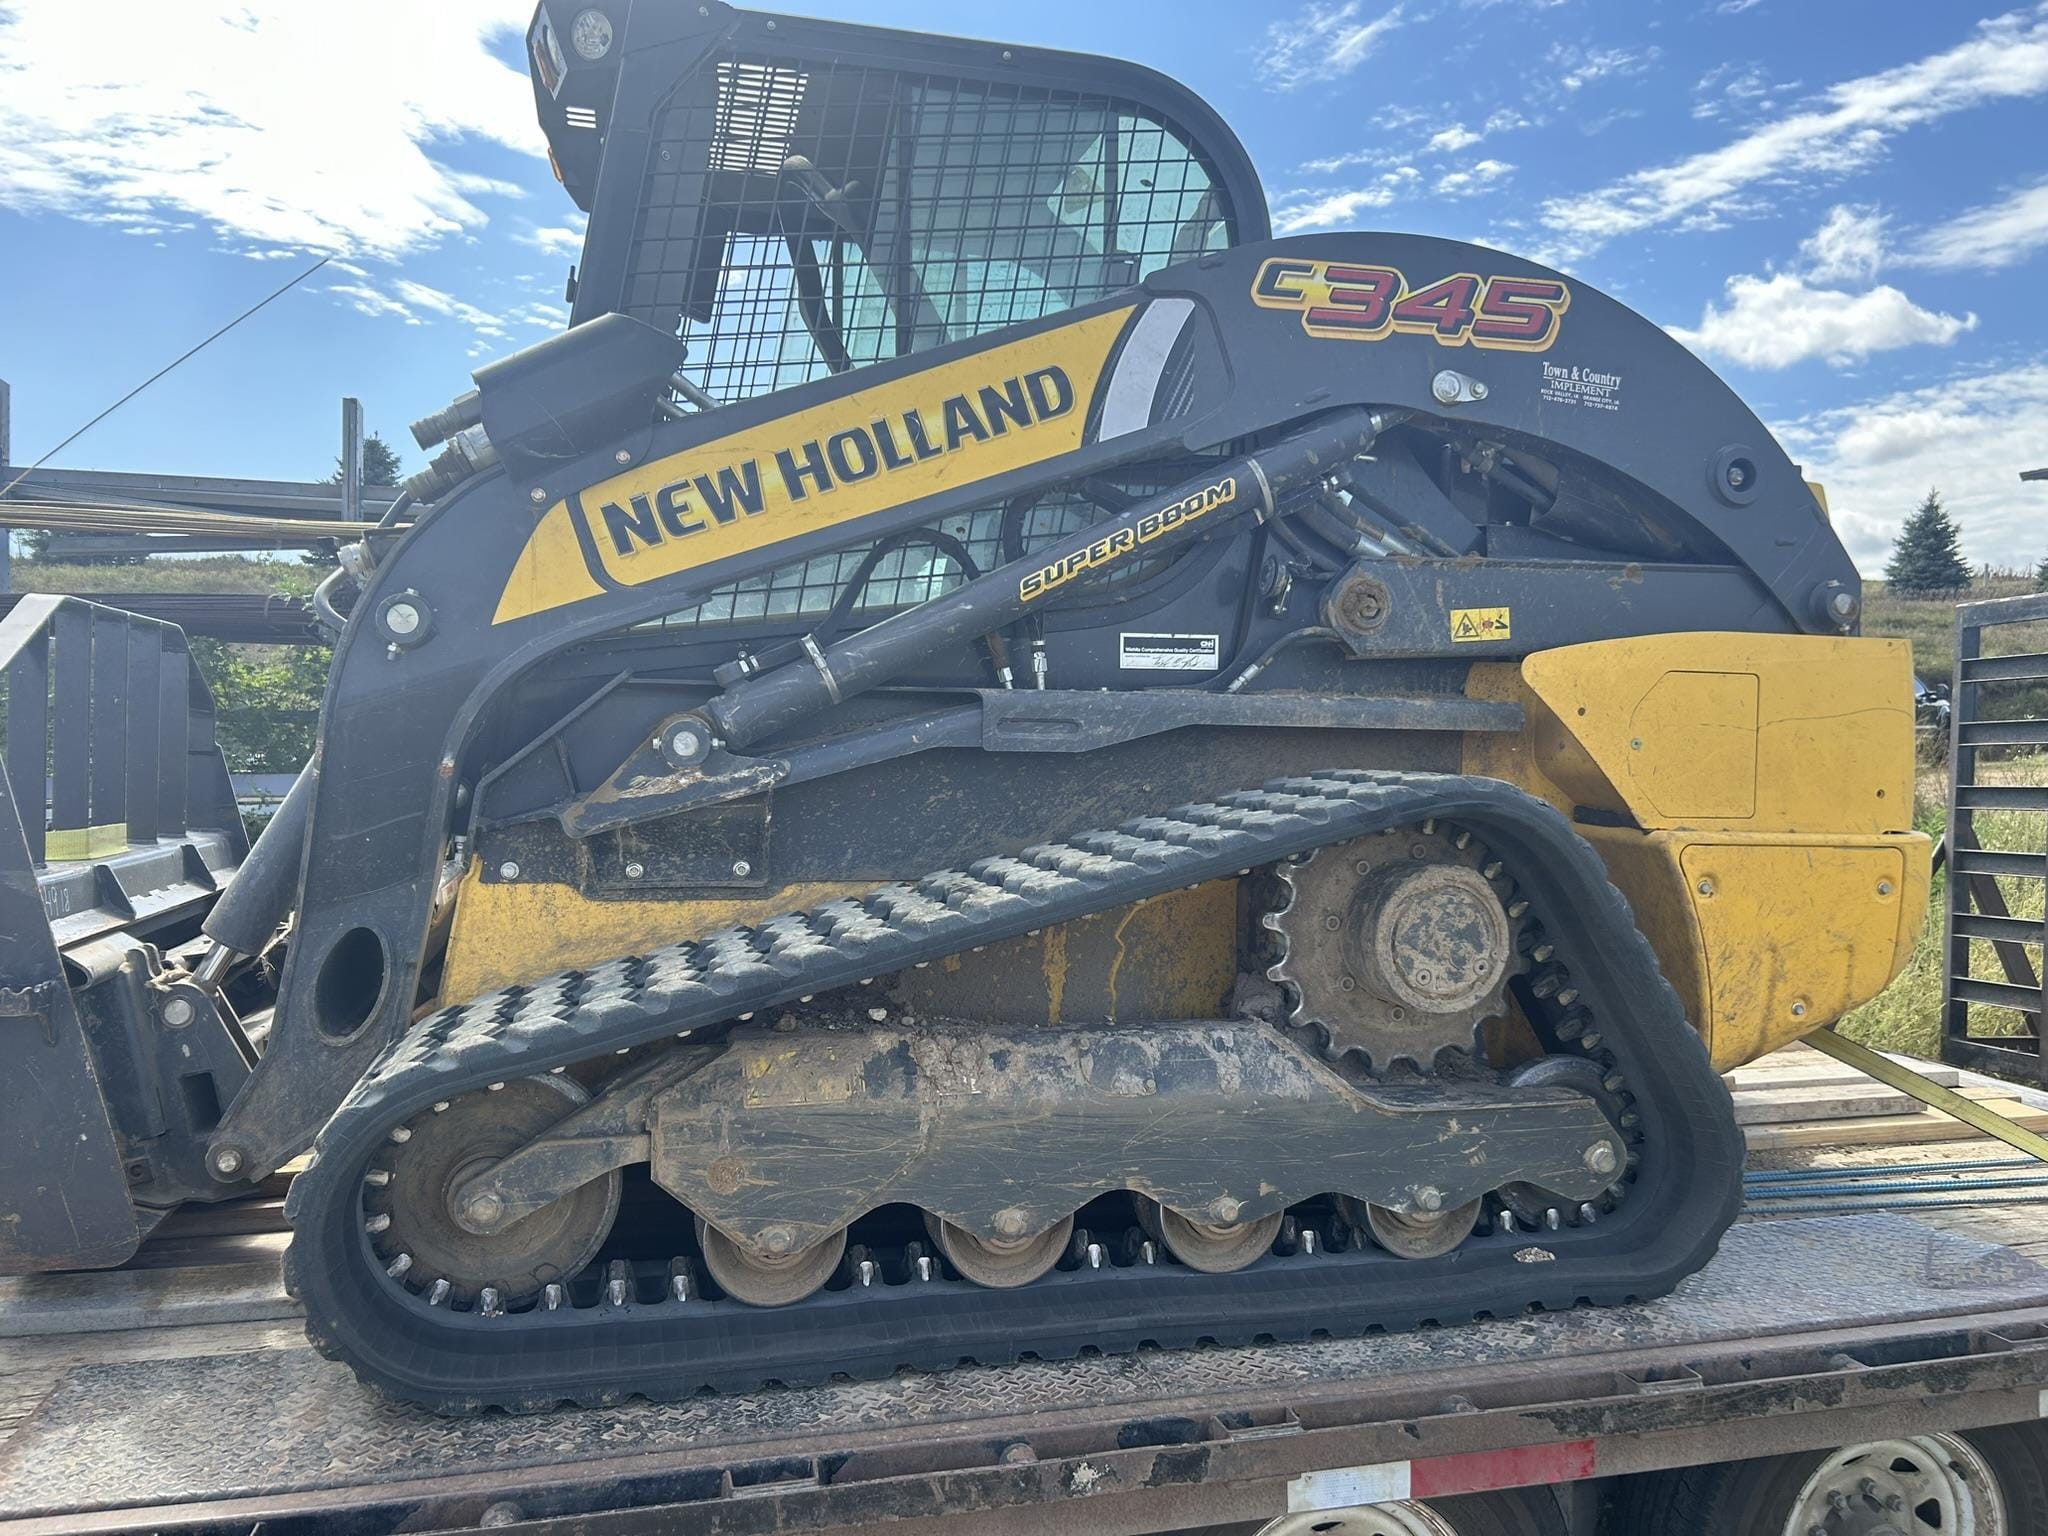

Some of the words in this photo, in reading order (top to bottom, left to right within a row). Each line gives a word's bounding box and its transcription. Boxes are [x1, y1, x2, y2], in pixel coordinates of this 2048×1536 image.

[1250, 257, 1571, 352] C345
[1543, 361, 1568, 379] Town
[1571, 366, 1580, 381] &
[1582, 368, 1622, 390] Country
[1551, 380, 1612, 398] IMPLEMENT
[600, 458, 765, 557] NEW
[774, 365, 1076, 503] HOLLAND
[1020, 528, 1134, 601] SUPER
[1137, 477, 1236, 544] BOOM
